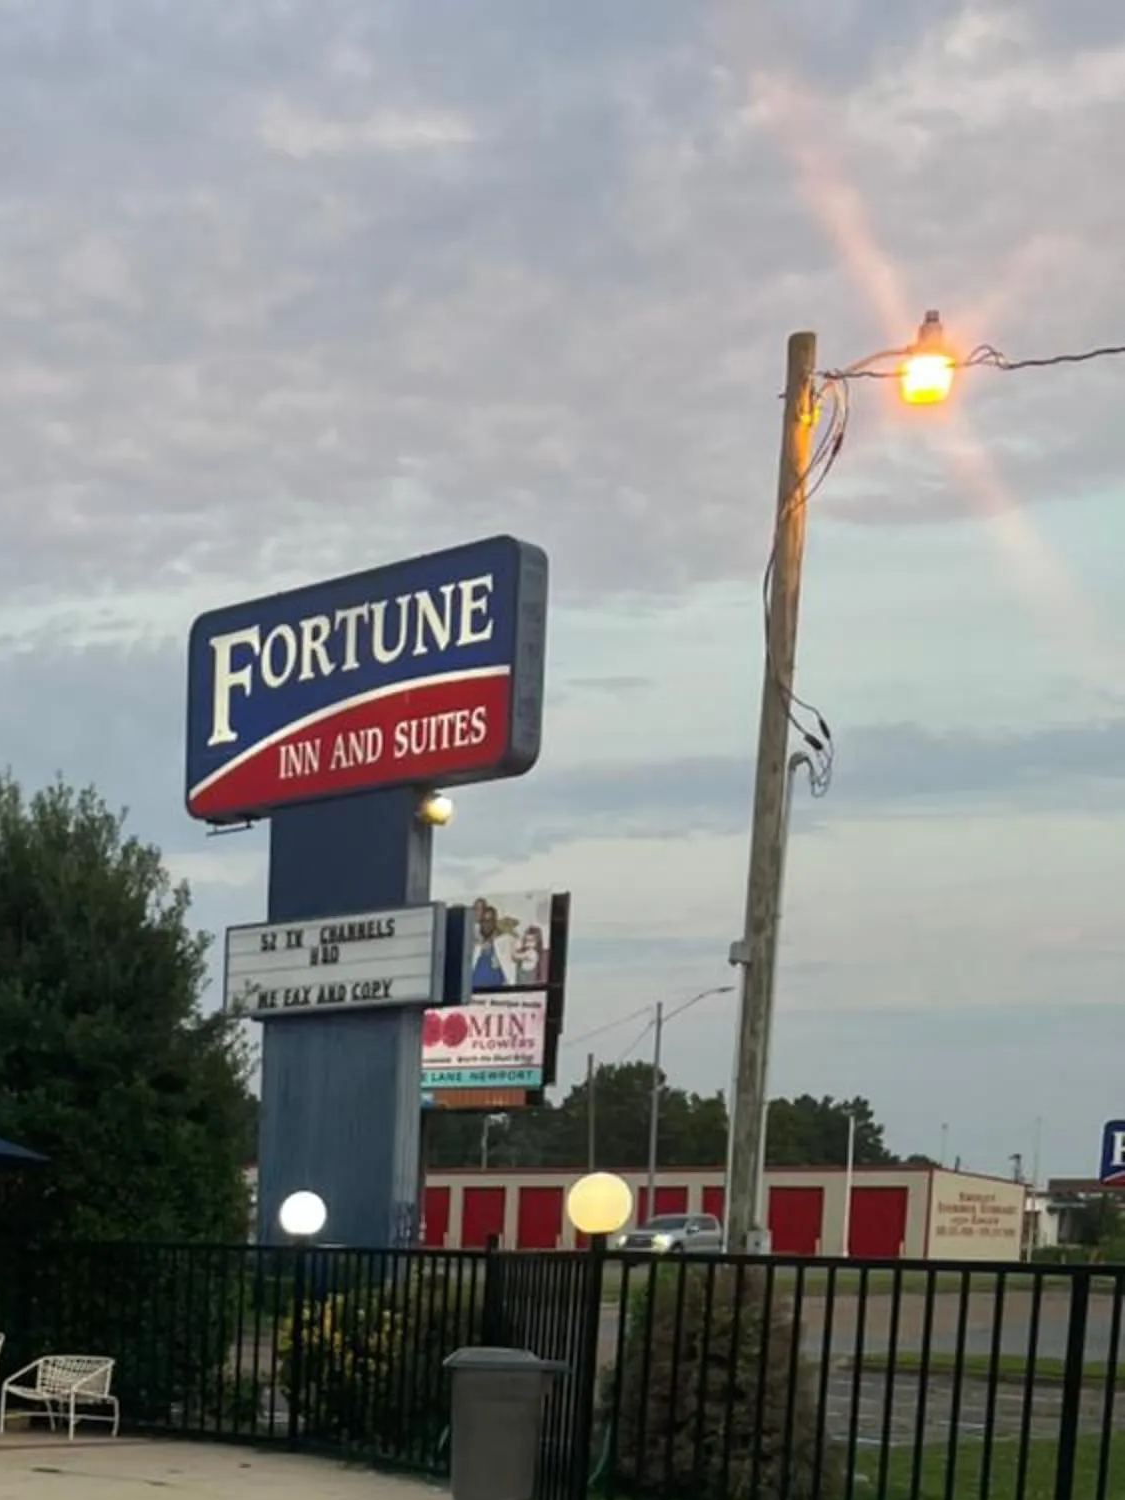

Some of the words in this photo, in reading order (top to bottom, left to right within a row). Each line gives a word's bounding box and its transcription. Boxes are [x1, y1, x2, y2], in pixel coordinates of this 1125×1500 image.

[206, 572, 495, 748] FORTUNE
[278, 737, 321, 780] INN
[329, 726, 384, 771] AND
[392, 705, 489, 760] SUITES
[319, 917, 397, 946] CHANNELS
[316, 982, 348, 1005] AND
[350, 977, 394, 1001] COPY
[469, 1069, 534, 1082] NEWPORT
